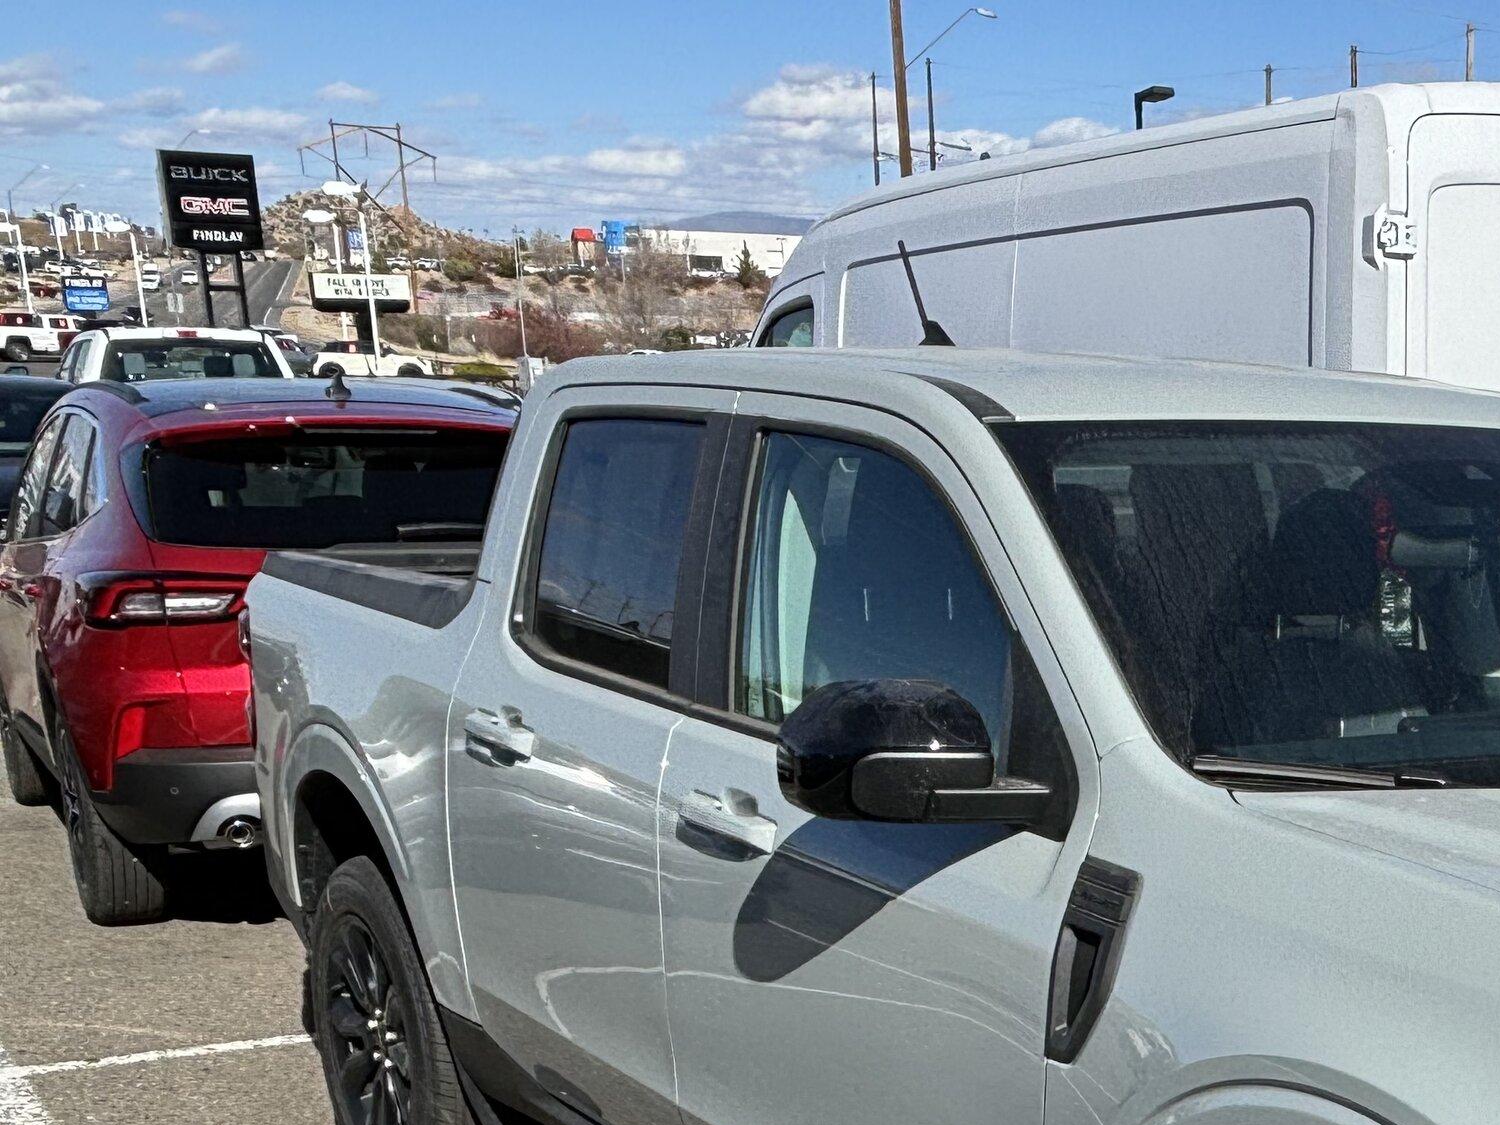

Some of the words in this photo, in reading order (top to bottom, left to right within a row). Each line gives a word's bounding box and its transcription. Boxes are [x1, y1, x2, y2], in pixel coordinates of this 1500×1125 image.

[169, 165, 249, 183] BUICK
[180, 195, 250, 216] GMC
[192, 229, 243, 242] FINDLAY
